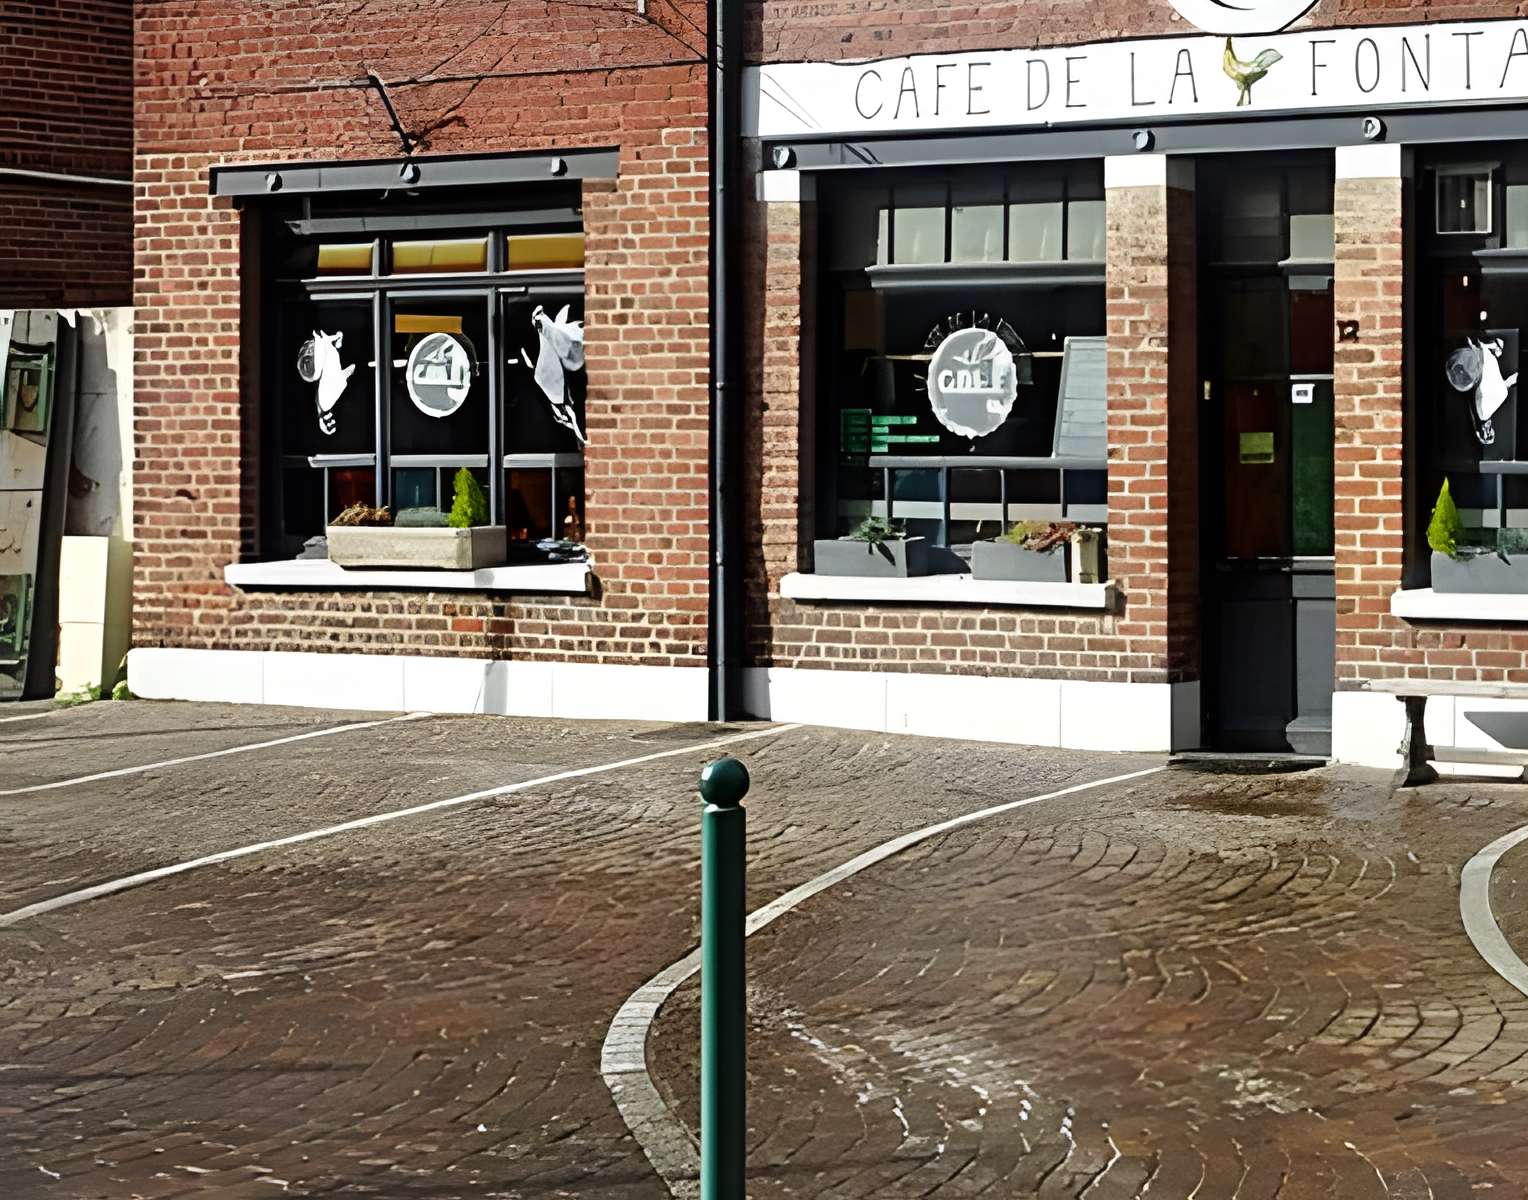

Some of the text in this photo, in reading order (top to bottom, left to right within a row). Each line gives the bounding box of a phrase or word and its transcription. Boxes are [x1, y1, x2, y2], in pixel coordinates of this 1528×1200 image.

[855, 62, 993, 120] CAFE
[1025, 56, 1088, 111] DE
[1130, 48, 1199, 107] LA
